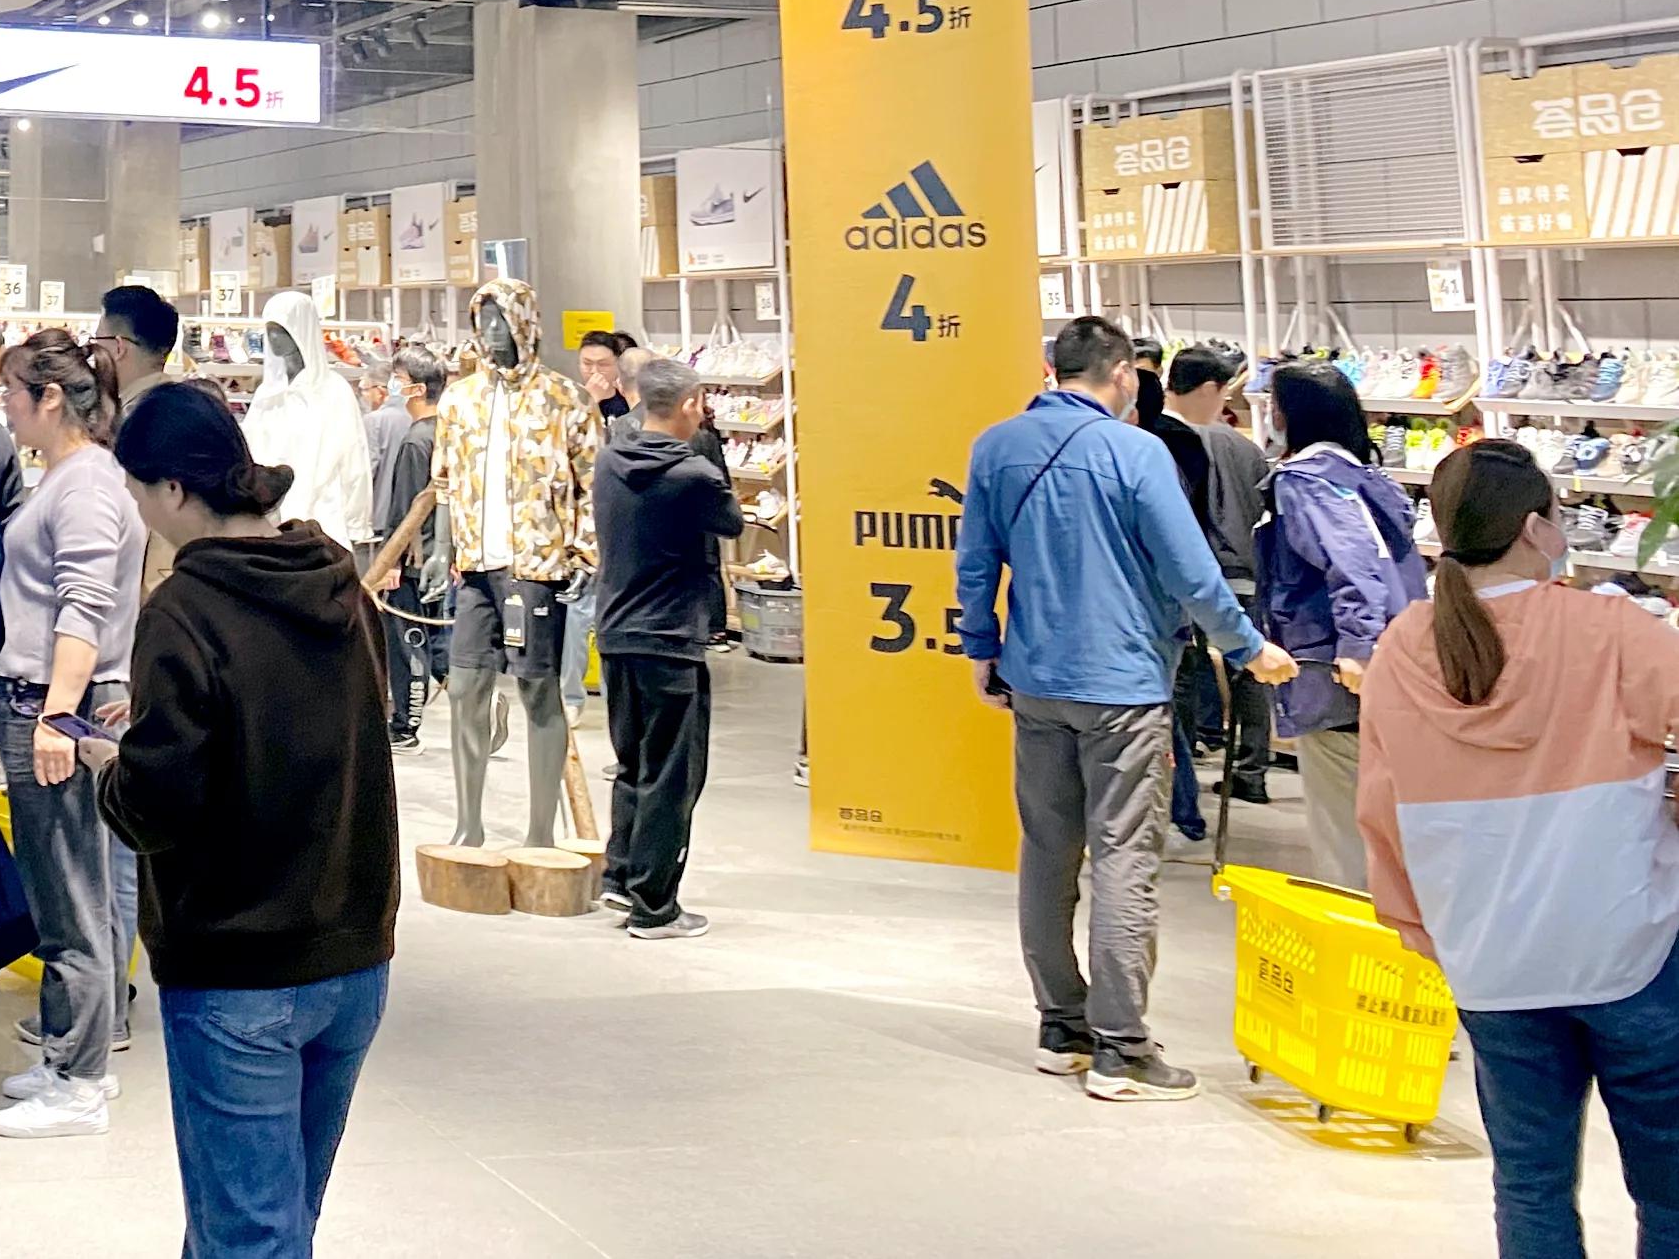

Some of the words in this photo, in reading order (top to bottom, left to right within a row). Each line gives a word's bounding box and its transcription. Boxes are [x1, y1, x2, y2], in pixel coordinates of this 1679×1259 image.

[184, 66, 284, 109] 4.5折
[845, 219, 987, 250] adidas
[4, 282, 21, 295] 36
[218, 288, 235, 302] 37
[880, 273, 962, 342] 4折
